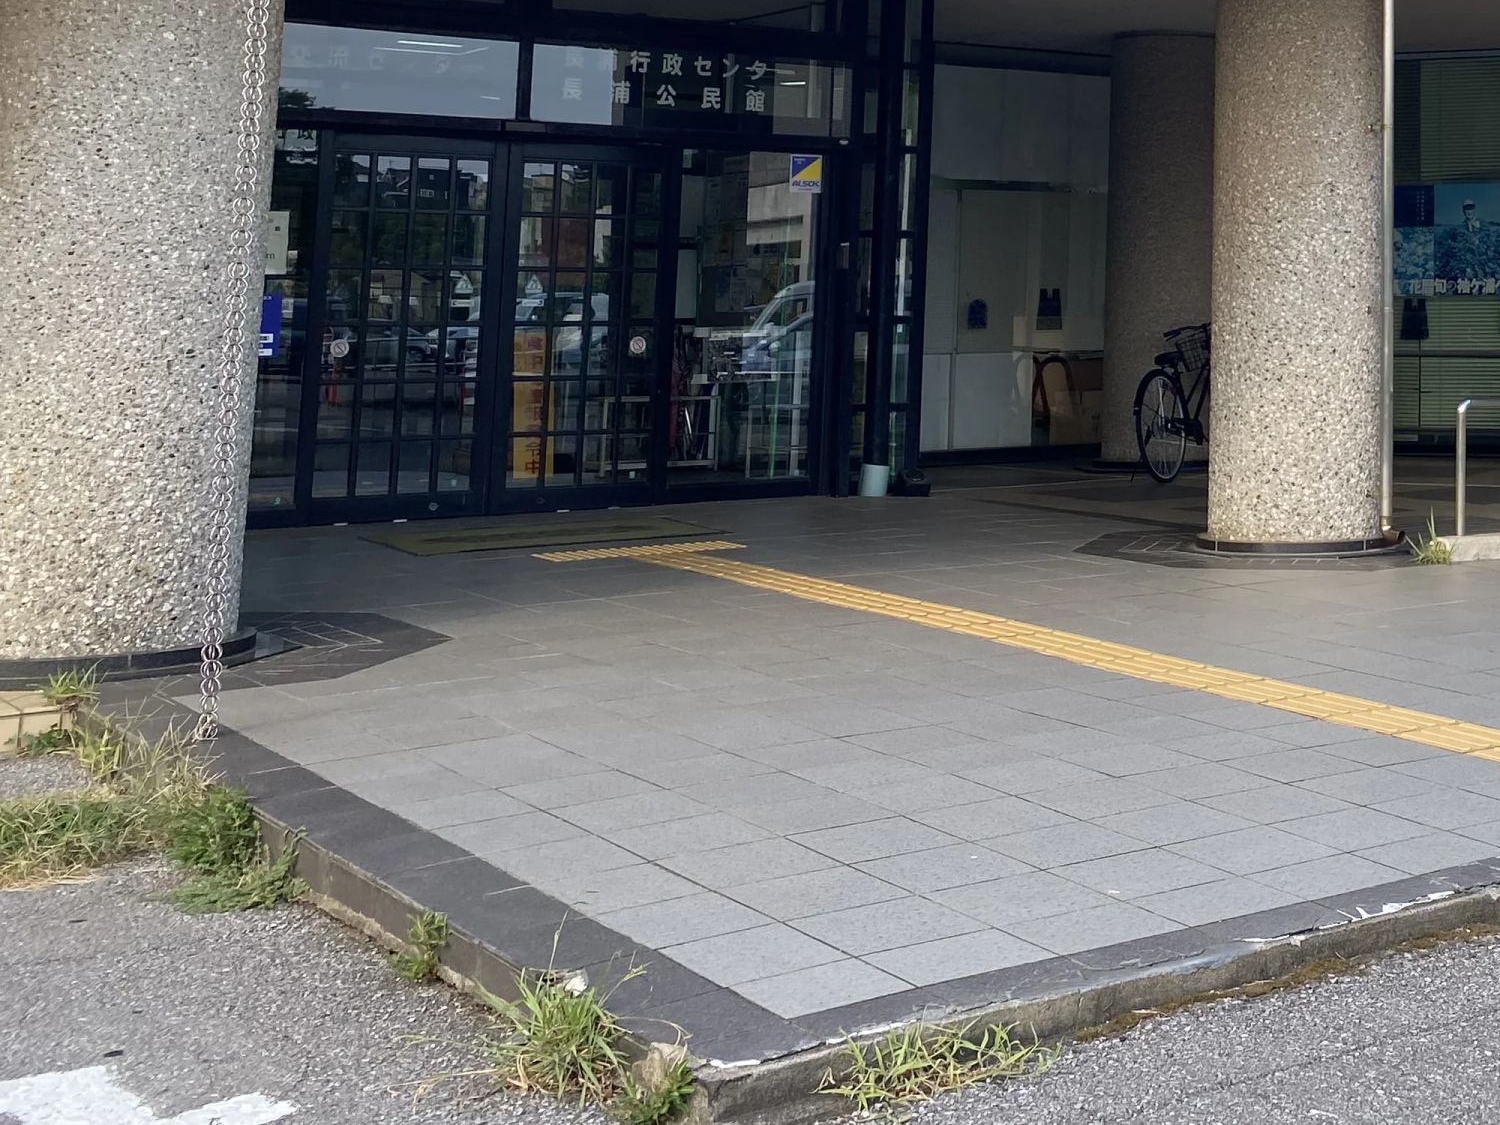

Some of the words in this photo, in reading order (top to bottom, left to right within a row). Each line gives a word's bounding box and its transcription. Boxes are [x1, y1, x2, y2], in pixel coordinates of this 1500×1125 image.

[564, 47, 797, 81] 長浦行政センター
[561, 77, 766, 114] 長浦公民館
[791, 179, 821, 188] ALSOK
